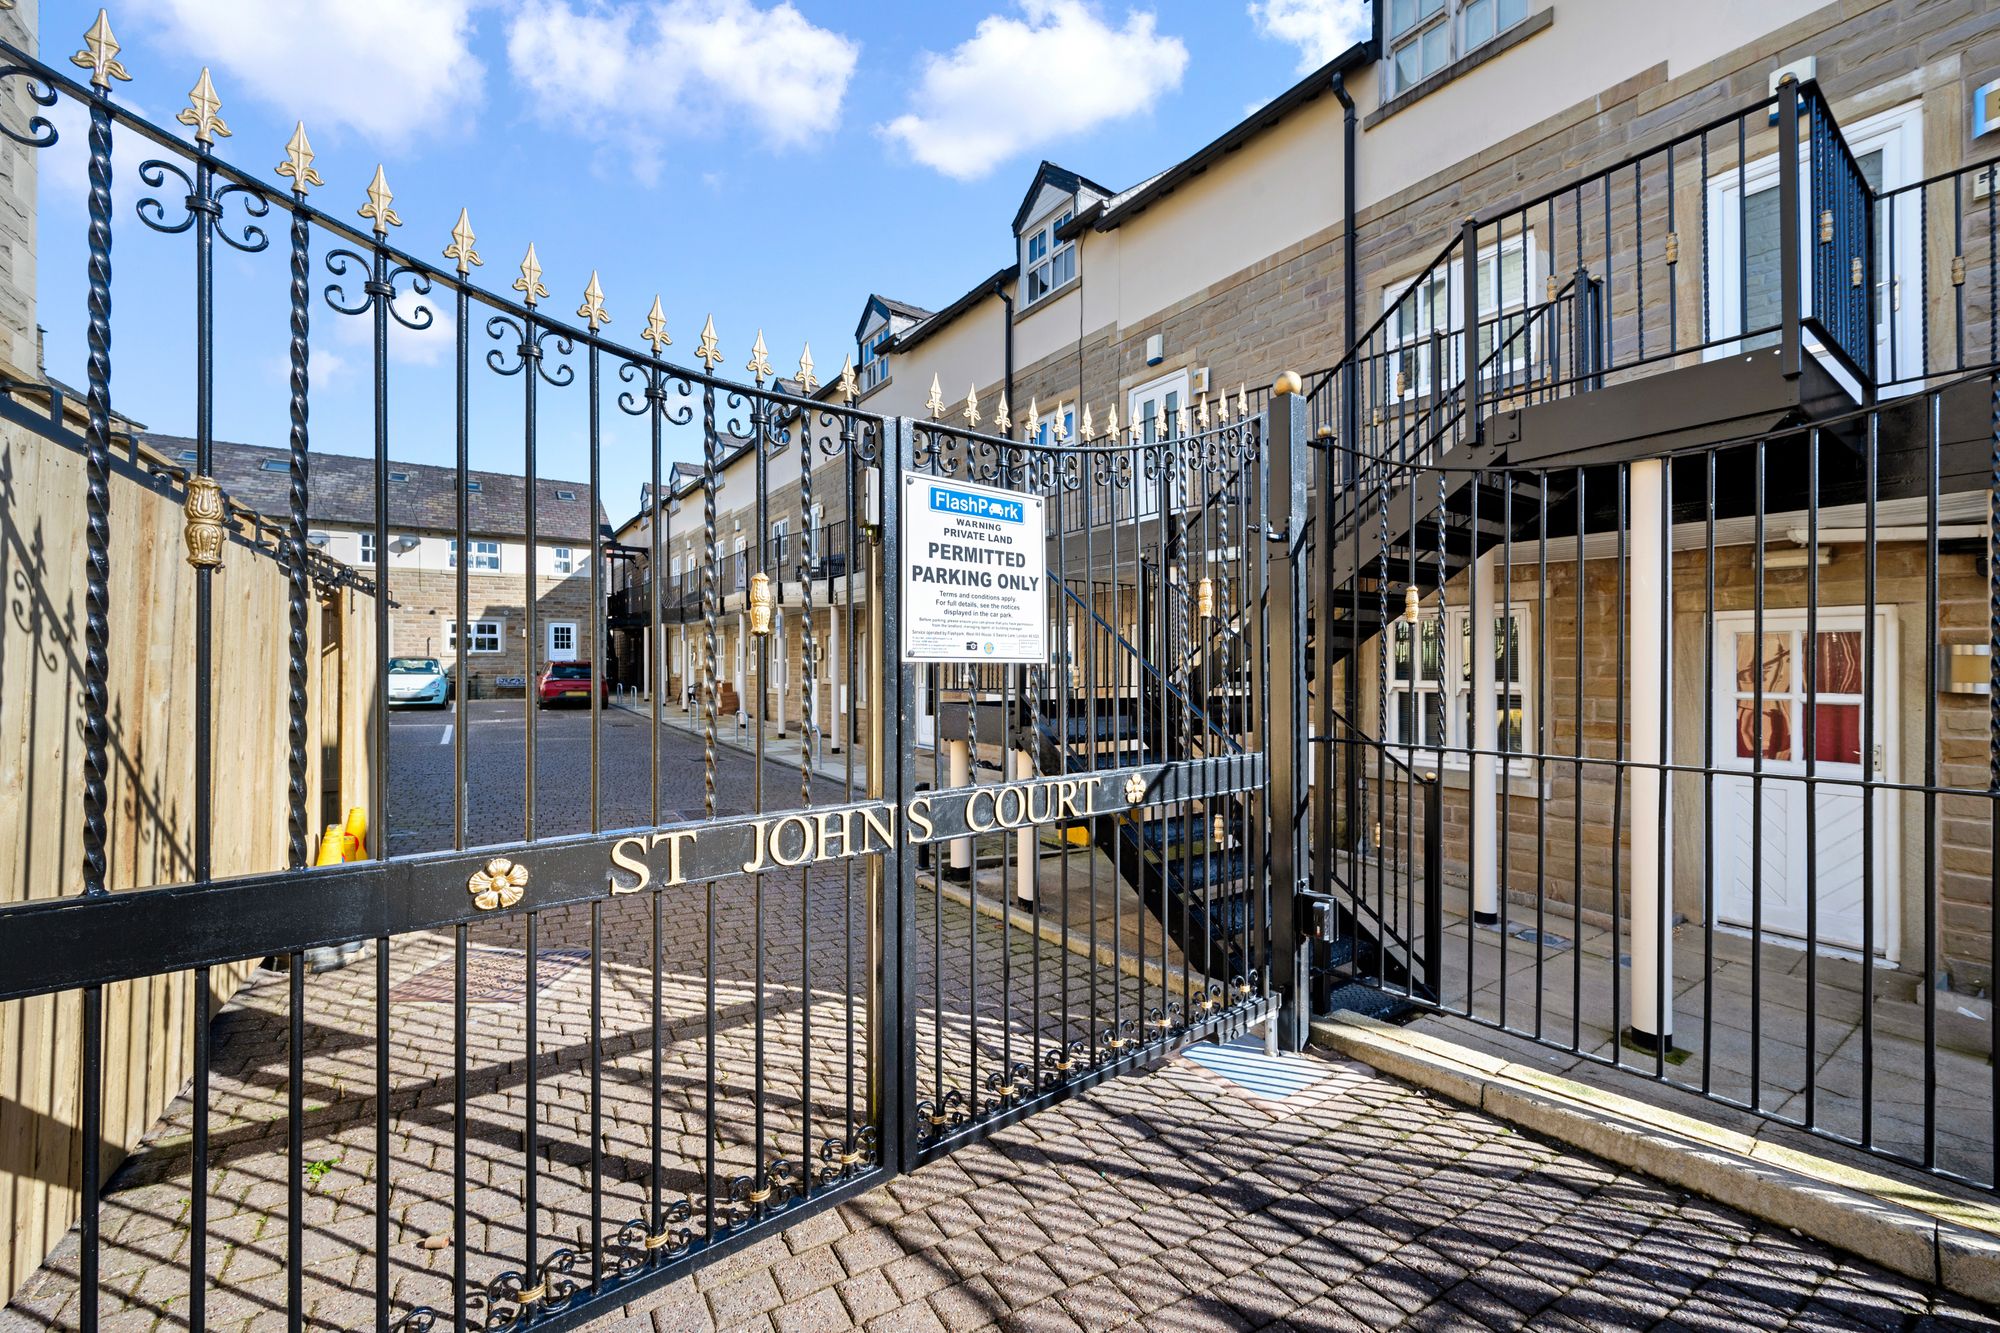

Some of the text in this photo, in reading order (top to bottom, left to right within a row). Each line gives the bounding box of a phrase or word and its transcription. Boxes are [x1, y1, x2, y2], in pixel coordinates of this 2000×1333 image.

[935, 490, 1019, 520] FlashPrk
[956, 518, 1002, 532] WARNING
[943, 527, 1013, 545] PRIVATE LAND
[928, 541, 1026, 568] PERMITTED
[912, 564, 1040, 592] PARKING ONLY
[939, 590, 958, 598] Terms
[971, 593, 1000, 601] conditions
[943, 609, 972, 617] displayed
[947, 599, 957, 607] full
[1000, 603, 1020, 611] notices
[610, 776, 1101, 896] ST JOHNS COURT
